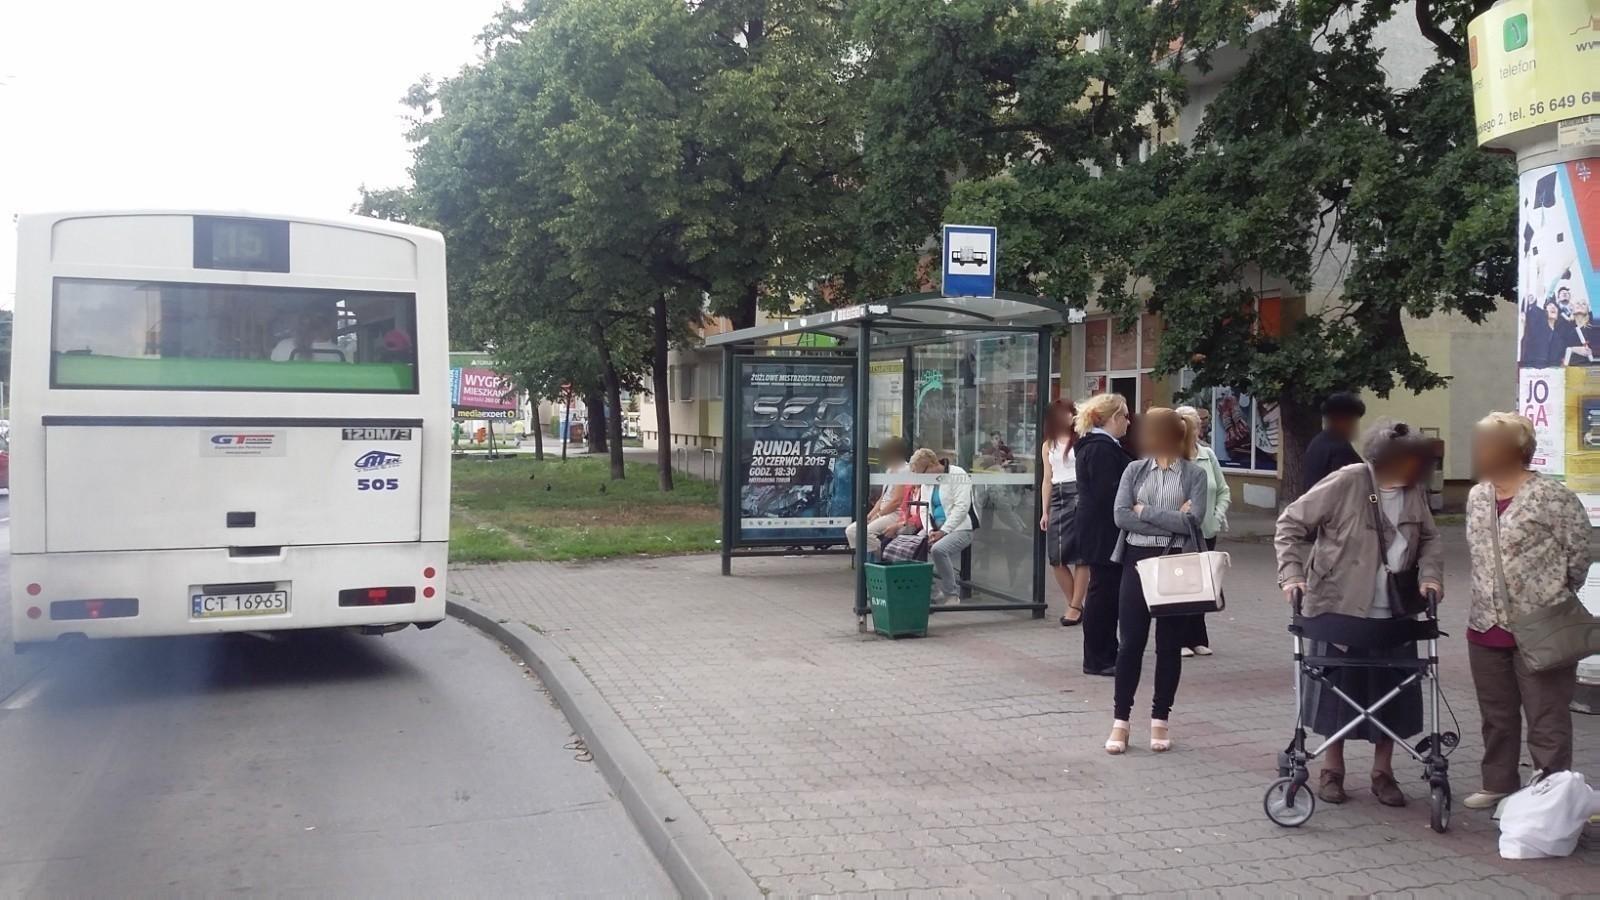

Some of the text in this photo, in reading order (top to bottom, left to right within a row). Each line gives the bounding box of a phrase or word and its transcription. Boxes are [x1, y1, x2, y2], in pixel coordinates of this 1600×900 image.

[1500, 59, 1537, 80] telefon
[1509, 107, 1526, 122] tel.
[1529, 101, 1545, 116] 56
[1549, 94, 1576, 111] 649
[821, 375, 846, 383] EUROPY
[1526, 379, 1549, 404] JO
[458, 410, 507, 418] mediaexpert
[752, 440, 801, 456] RUNDA
[804, 440, 812, 455] 1
[751, 457, 826, 466] 20 CZERWCA 2015
[749, 467, 797, 476] GODZ. 18:30
[357, 478, 399, 491] 505
[204, 594, 283, 611] CT 16965
